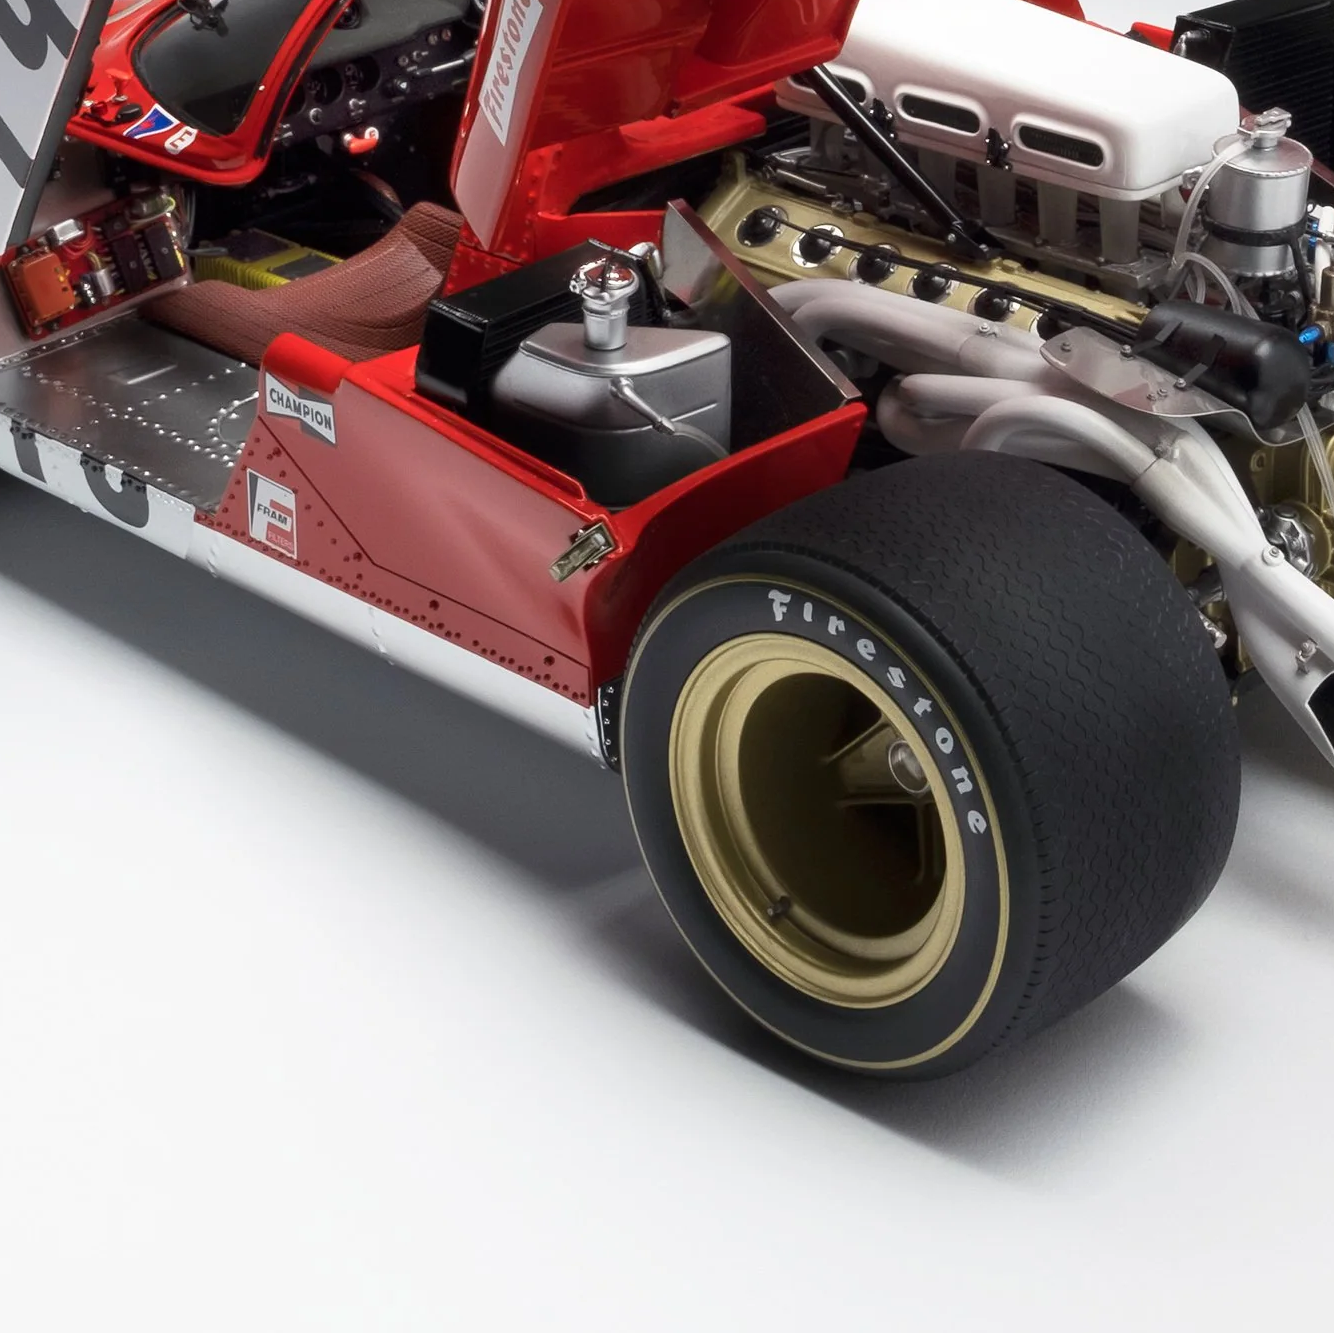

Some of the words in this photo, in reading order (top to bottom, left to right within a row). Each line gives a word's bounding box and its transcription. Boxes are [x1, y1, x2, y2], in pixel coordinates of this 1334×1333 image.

[269, 387, 332, 431] CHAMPION
[257, 502, 288, 526] FRAM
[768, 589, 987, 834] Firestone
